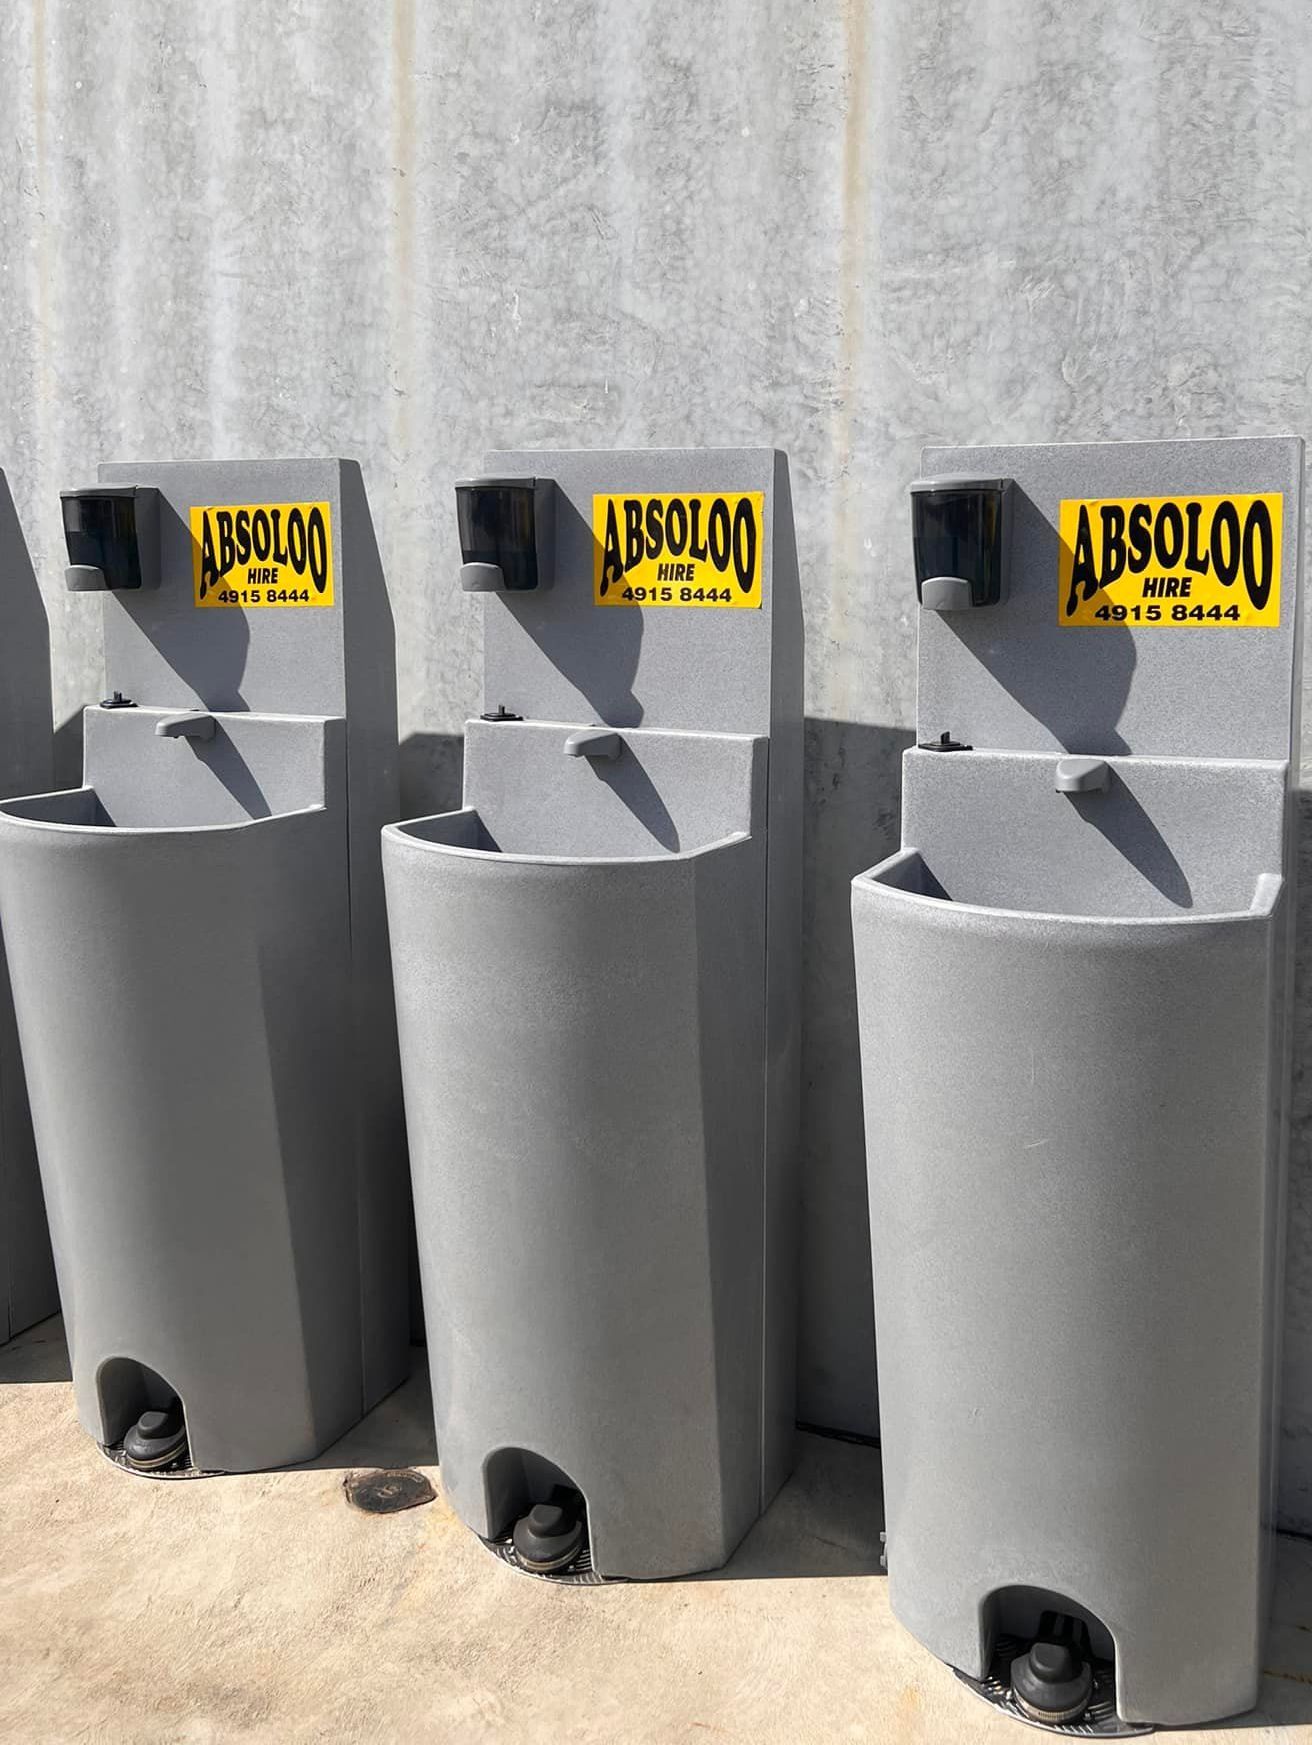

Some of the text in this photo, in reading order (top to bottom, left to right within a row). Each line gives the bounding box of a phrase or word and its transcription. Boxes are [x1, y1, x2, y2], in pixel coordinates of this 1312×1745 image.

[200, 507, 327, 600] ABSOLOO
[600, 497, 757, 597] ABSOLOO
[1066, 500, 1273, 617] ABSOLOO
[247, 568, 279, 584] HIRE
[657, 563, 695, 581] HIRE
[218, 589, 310, 603] 4915 8444
[621, 587, 732, 602] 4915 8444
[1142, 577, 1192, 598] HIRE
[1094, 604, 1240, 621] 4915 8444
